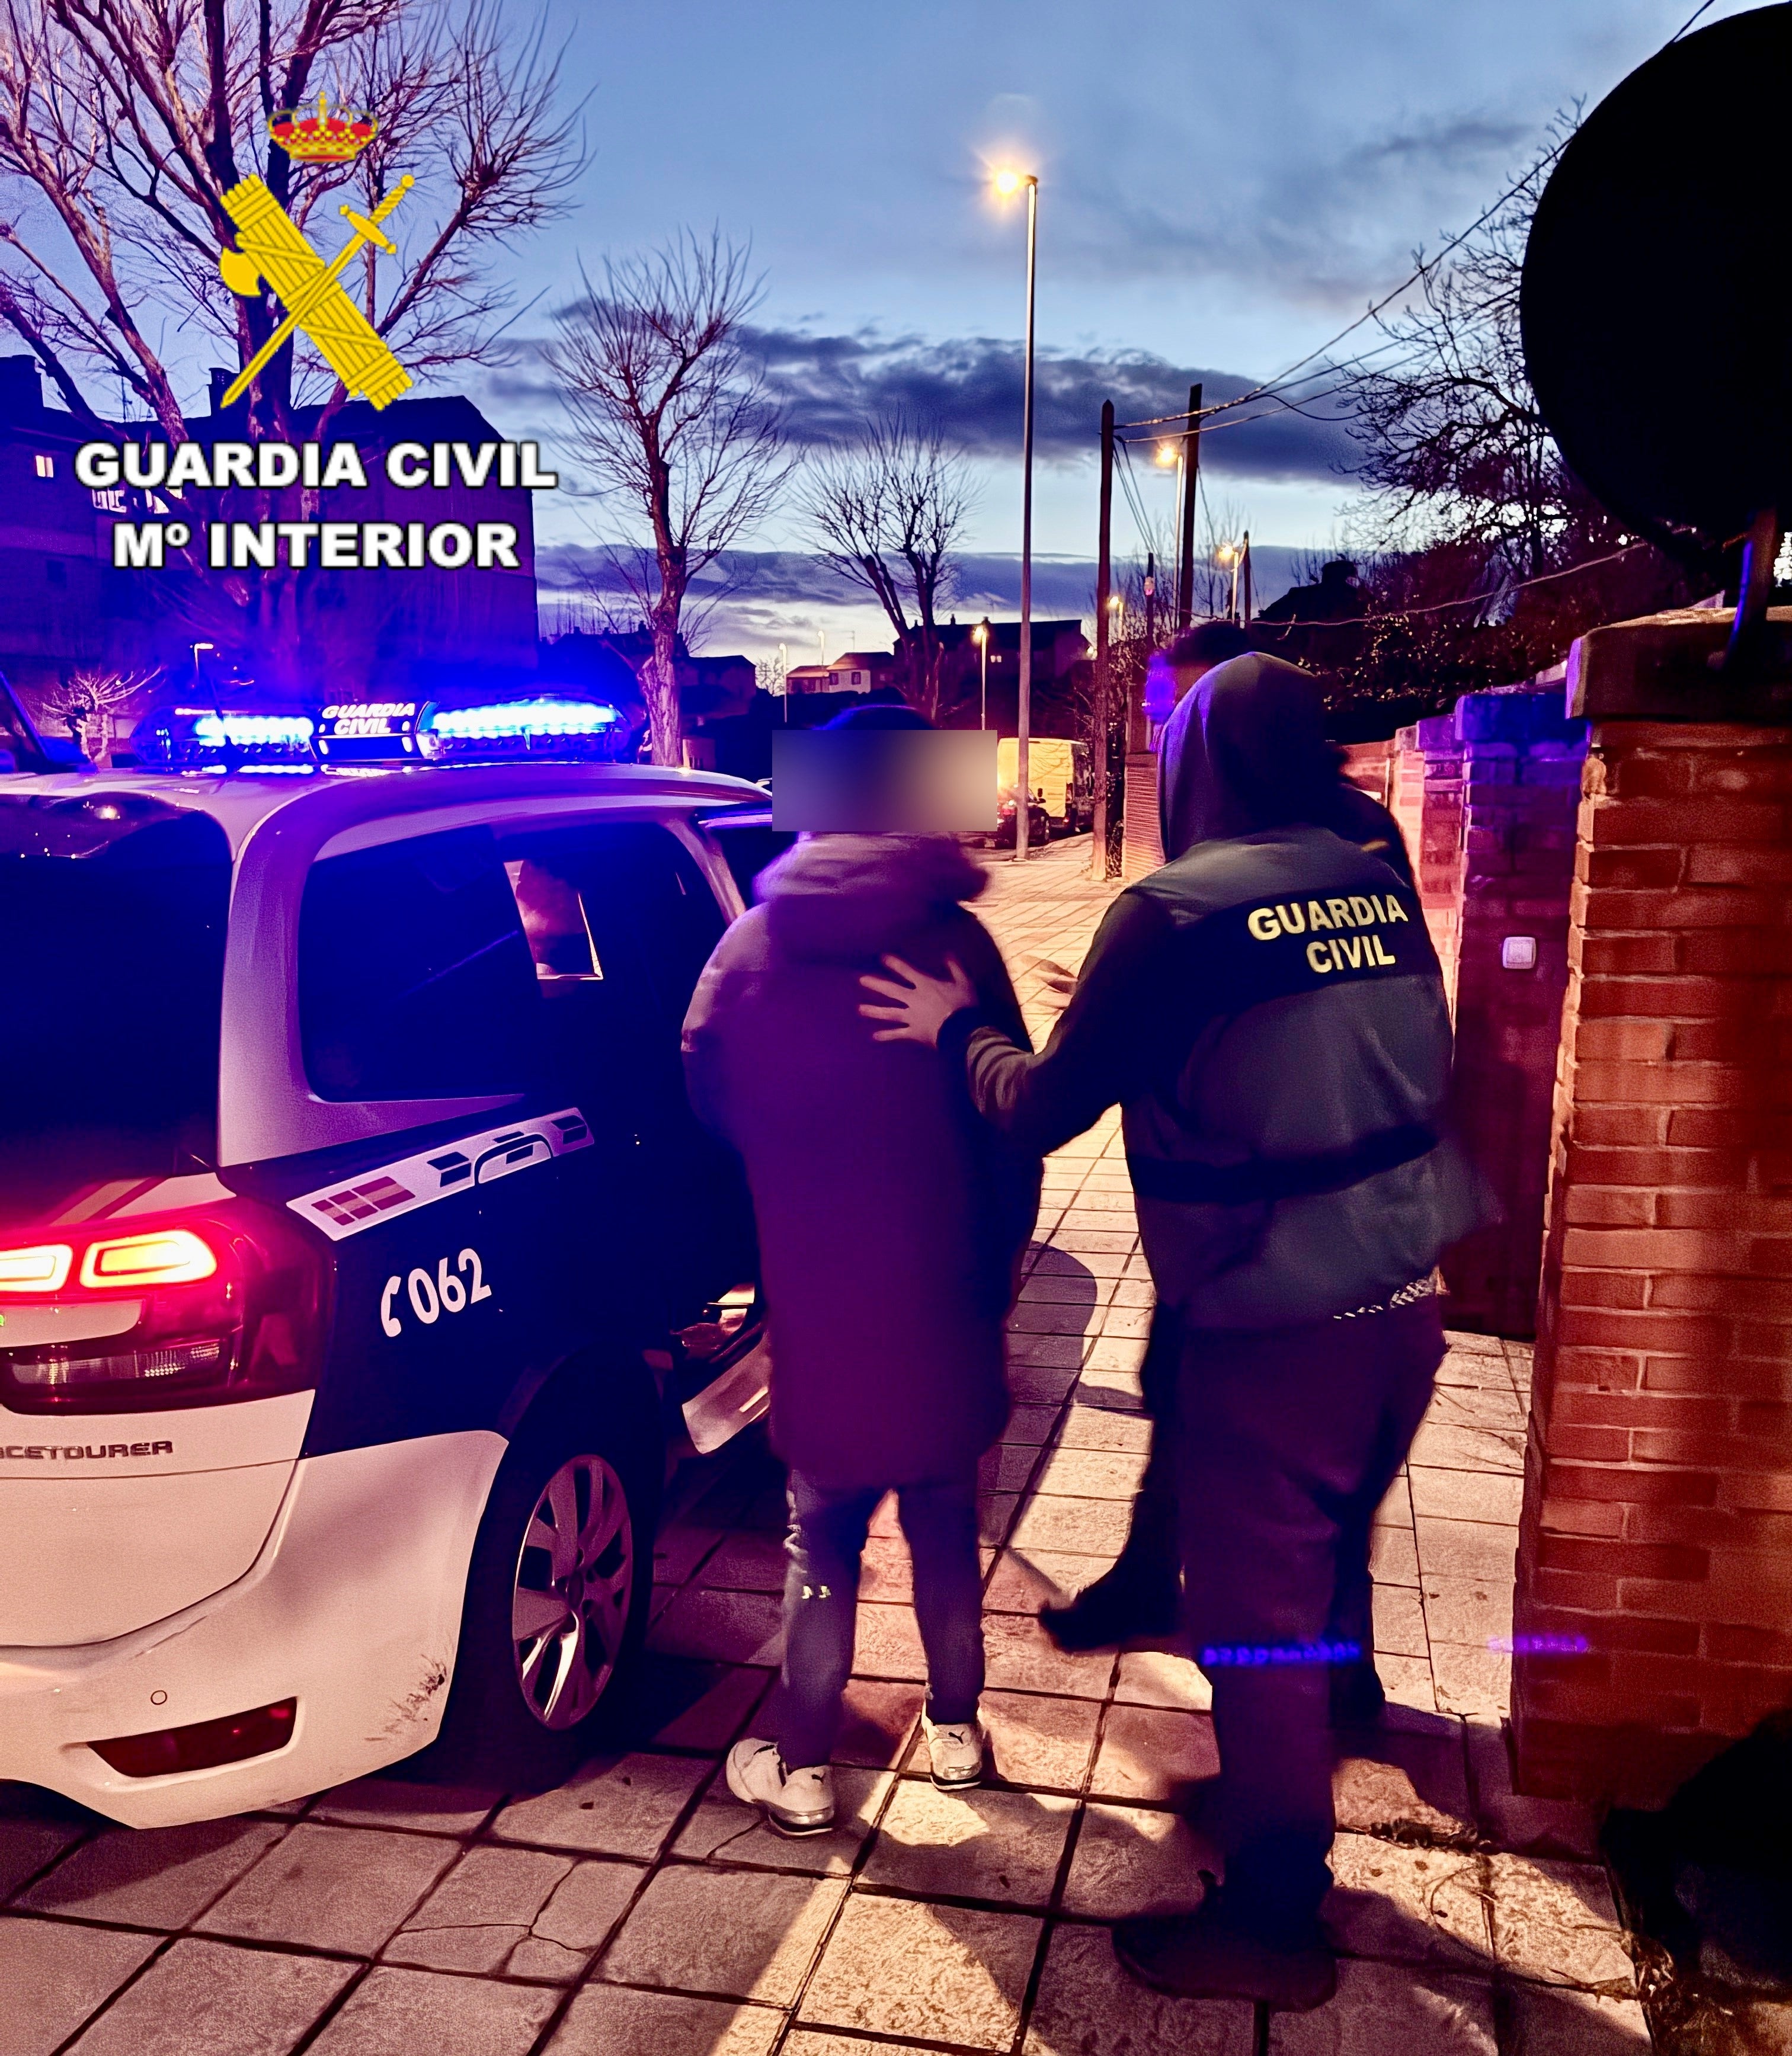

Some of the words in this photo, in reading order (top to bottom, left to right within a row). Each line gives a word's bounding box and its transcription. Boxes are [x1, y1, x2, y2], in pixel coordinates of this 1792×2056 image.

[322, 703, 415, 719] GUARDIA
[334, 718, 391, 735] CIVIL
[1248, 895, 1408, 940] GUARDIA
[1307, 935, 1396, 973] CIVIL
[408, 1248, 492, 1324] 062
[0, 1440, 174, 1460] CETOURER
